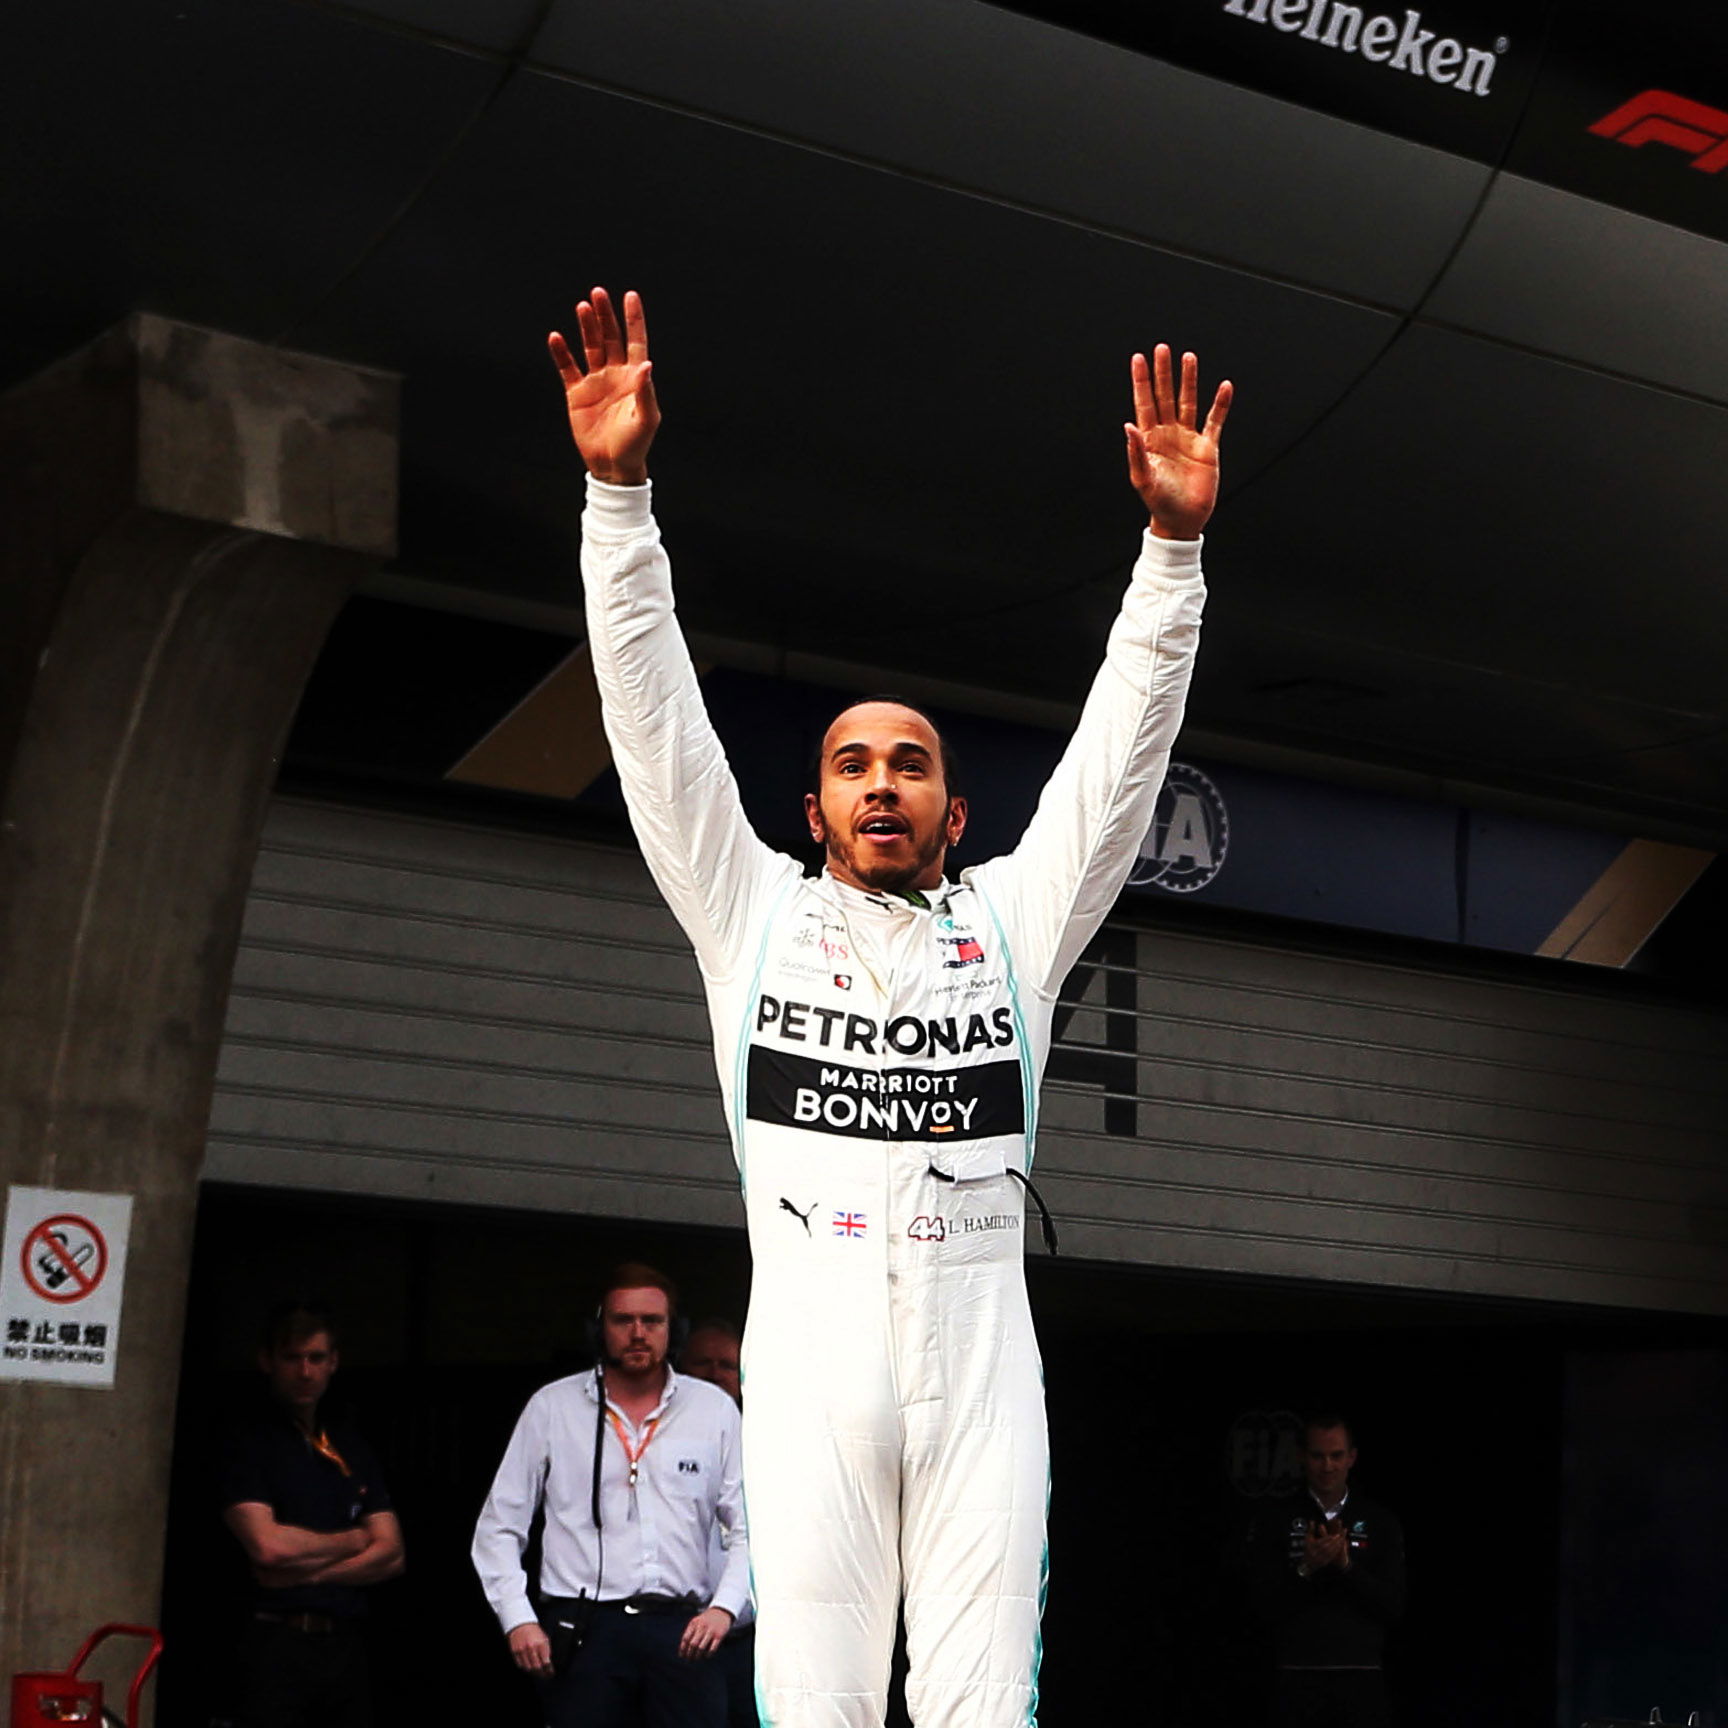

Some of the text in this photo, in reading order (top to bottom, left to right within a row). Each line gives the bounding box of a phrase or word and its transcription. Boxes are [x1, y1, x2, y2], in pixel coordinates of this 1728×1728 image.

[757, 993, 1014, 1058] PETRONAS
[793, 1087, 979, 1132] BONVOY
[964, 1215, 1020, 1233] HAMILTON
[4, 1346, 105, 1364] NO SMOKING
